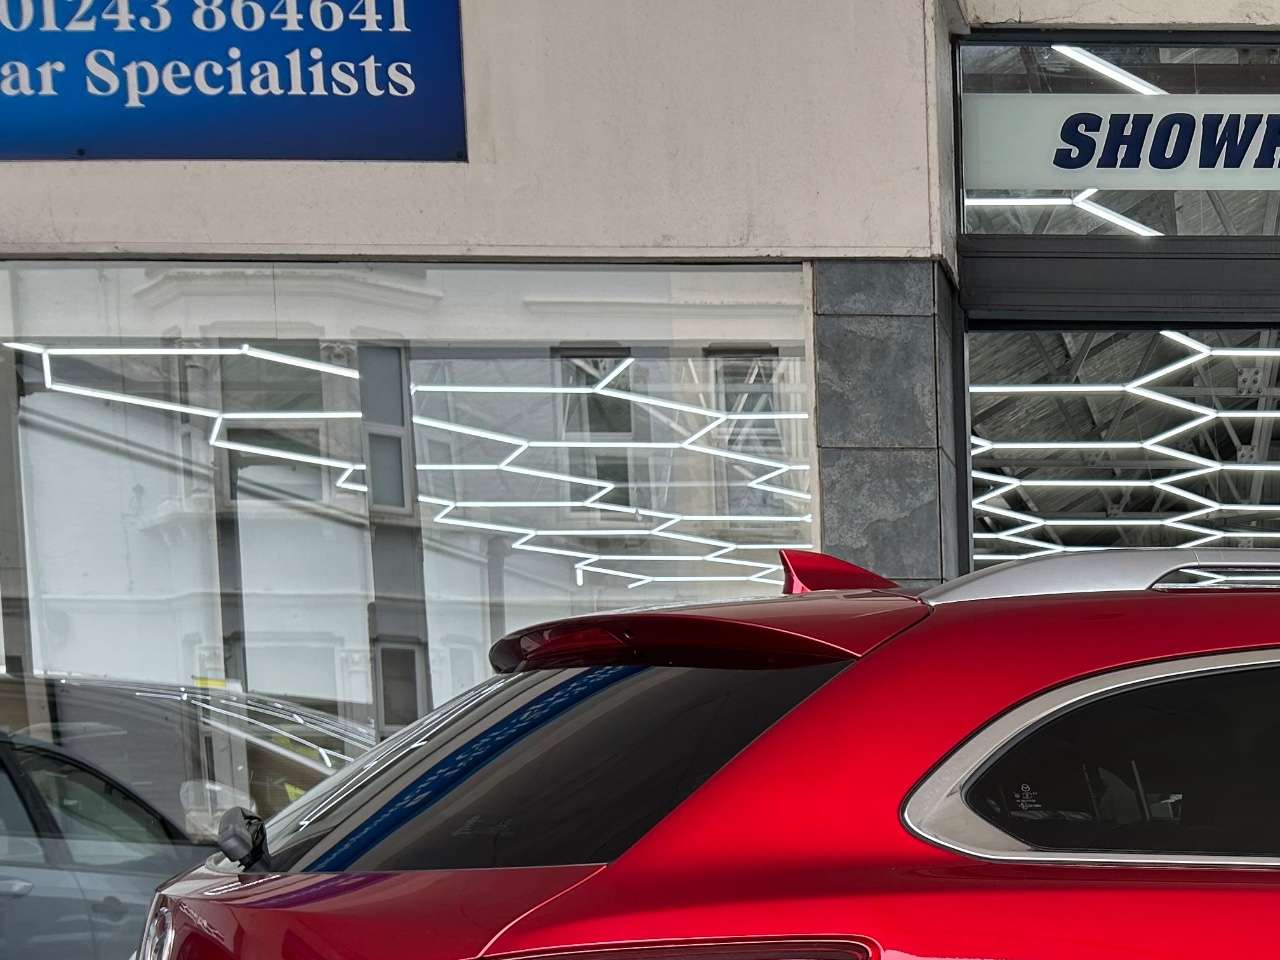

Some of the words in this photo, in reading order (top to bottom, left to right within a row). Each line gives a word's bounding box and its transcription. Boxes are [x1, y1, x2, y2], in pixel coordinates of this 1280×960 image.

[0, 0, 172, 32] 01243
[192, 0, 411, 32] 864641
[0, 60, 65, 96] ar
[85, 47, 415, 107] Specialists
